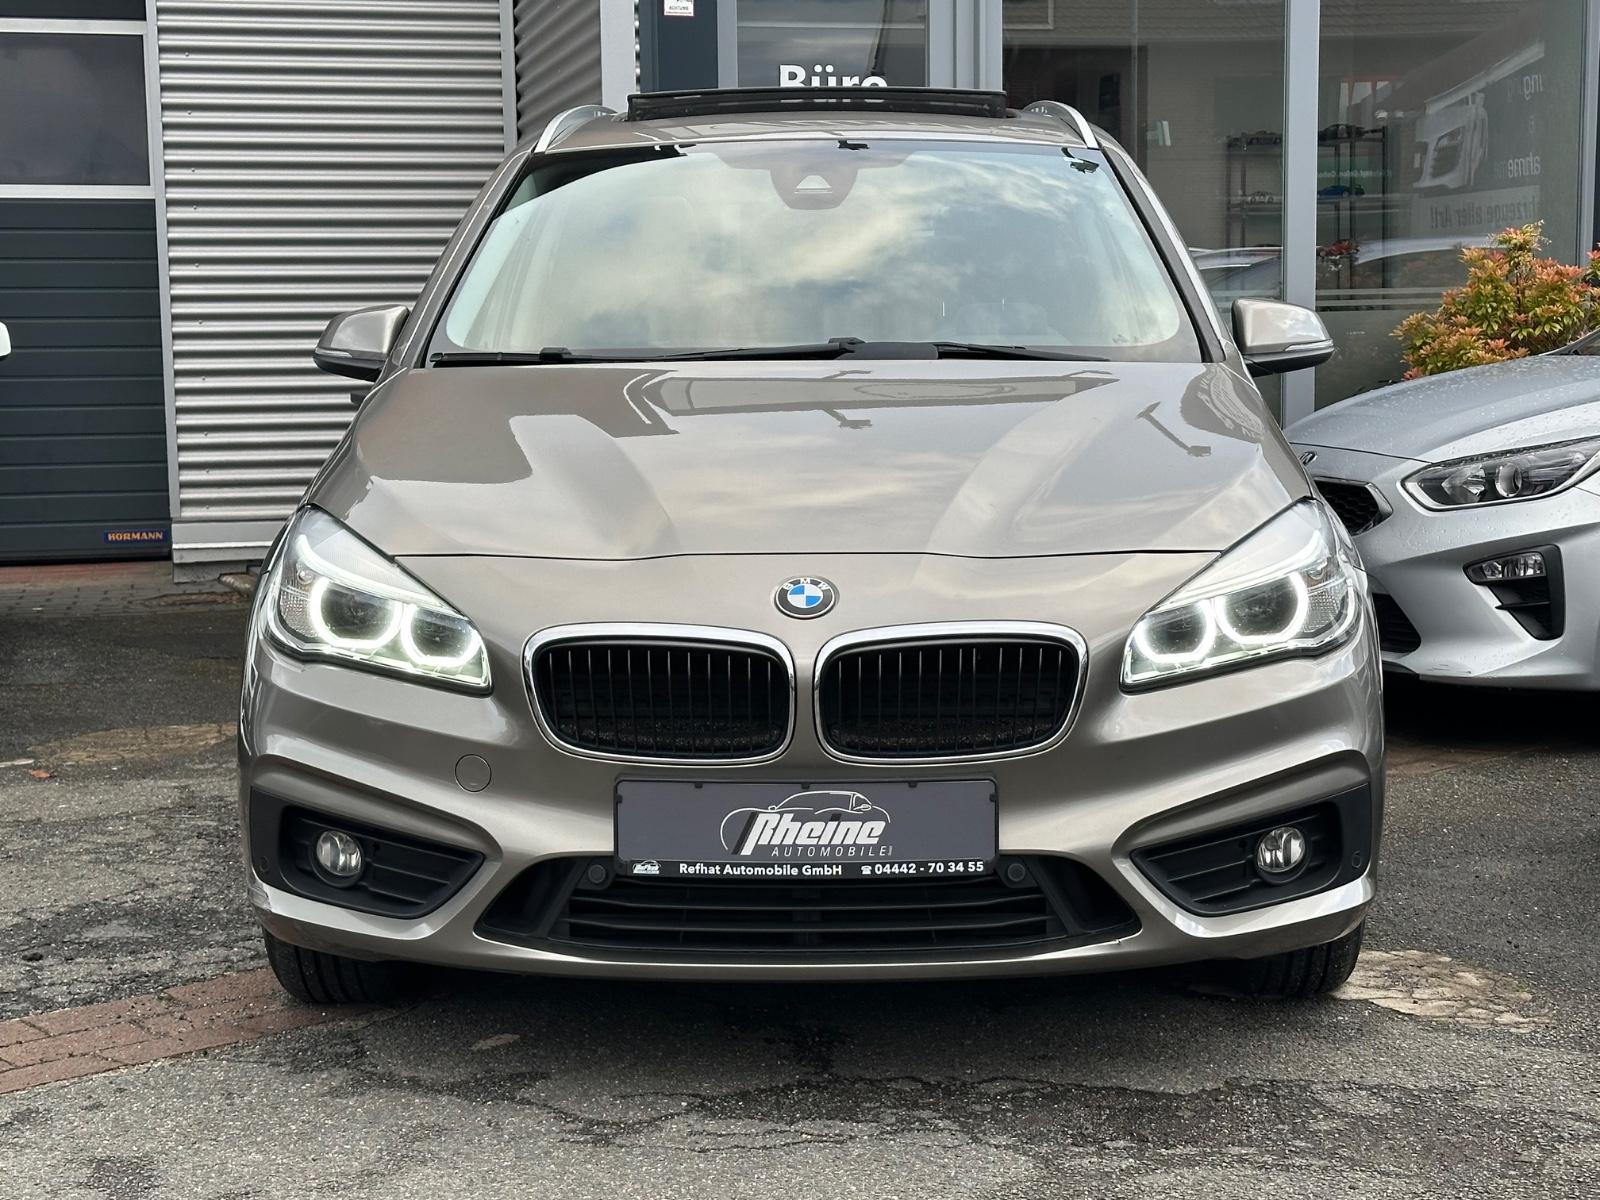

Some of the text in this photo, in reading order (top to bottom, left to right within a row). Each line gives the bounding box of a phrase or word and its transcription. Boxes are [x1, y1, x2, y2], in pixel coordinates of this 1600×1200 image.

[740, 813, 886, 856] Rheine
[771, 846, 888, 858] AUTOMOBILE
[679, 863, 721, 875] Refhat
[723, 864, 799, 876] Automobile
[802, 864, 842, 876] GmbH
[874, 863, 917, 875] 04442
[927, 862, 944, 873] 70
[947, 862, 965, 873] 34
[967, 861, 985, 872] 55
